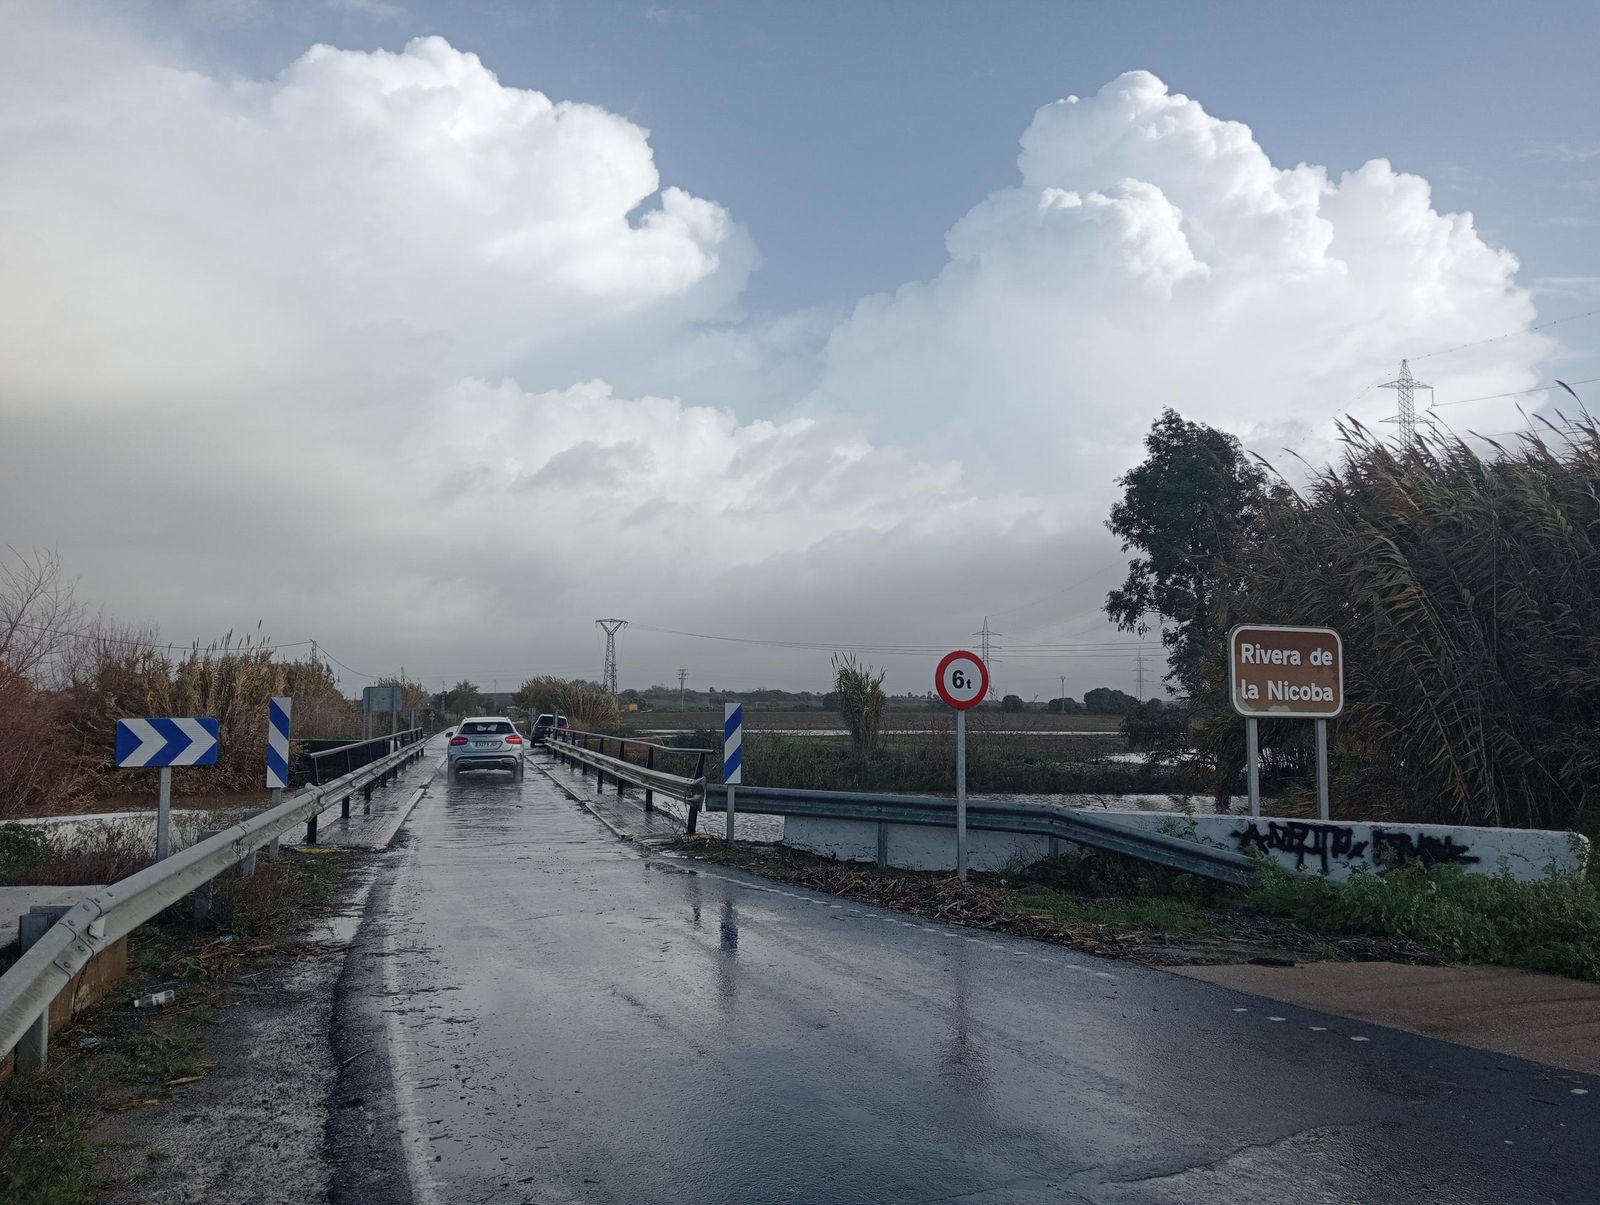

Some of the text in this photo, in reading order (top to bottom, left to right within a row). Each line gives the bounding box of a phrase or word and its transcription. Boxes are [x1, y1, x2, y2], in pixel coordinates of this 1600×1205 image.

[1240, 642, 1333, 666] Rivera de
[1240, 679, 1334, 702] la Nicoba
